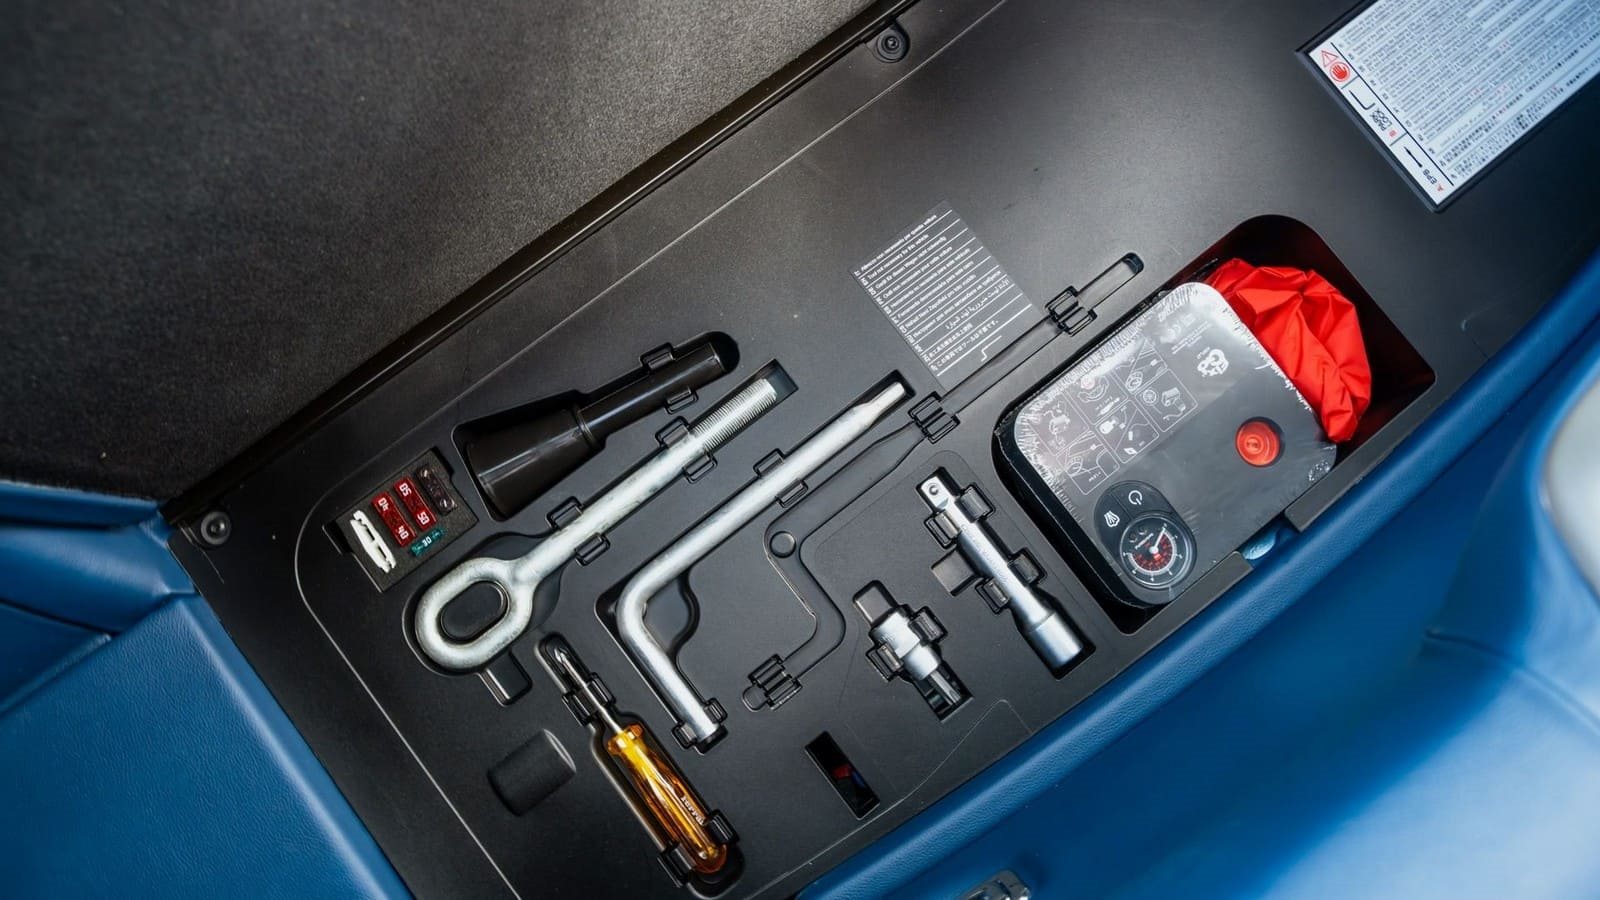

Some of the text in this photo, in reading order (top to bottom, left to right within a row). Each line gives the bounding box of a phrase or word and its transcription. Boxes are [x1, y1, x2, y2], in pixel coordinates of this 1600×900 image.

[1370, 114, 1386, 131] PARK
[1375, 108, 1392, 127] LOCK
[1423, 169, 1437, 184] EPB
[883, 253, 902, 267] necessary
[915, 234, 928, 244] vehicle
[399, 483, 412, 496] 50
[378, 497, 389, 511] 40
[417, 511, 430, 525] 50
[397, 525, 409, 539] 40
[423, 536, 432, 547] 30
